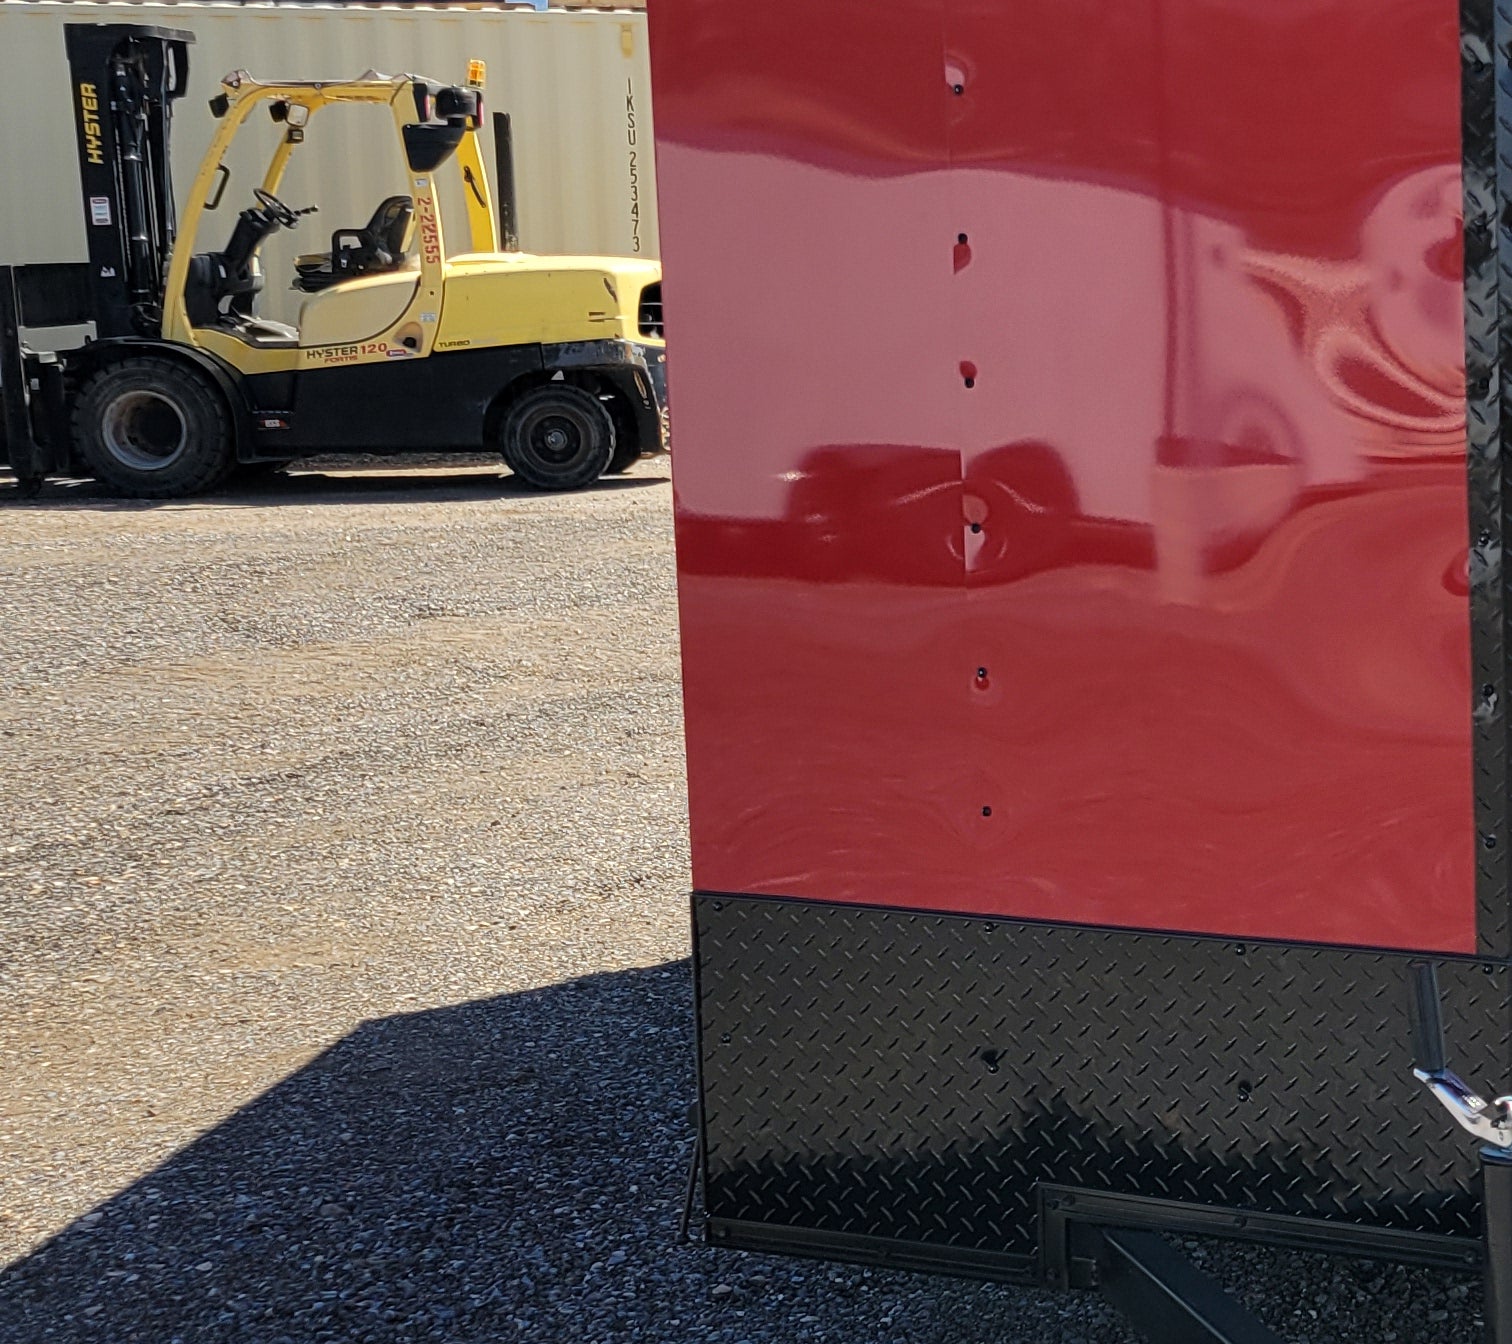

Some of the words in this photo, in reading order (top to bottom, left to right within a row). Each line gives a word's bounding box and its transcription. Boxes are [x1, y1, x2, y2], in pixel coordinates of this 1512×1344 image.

[80, 82, 104, 164] HYSTER
[629, 151, 641, 253] 253473
[306, 345, 358, 360] HYSTER
[360, 343, 388, 355] 120
[438, 339, 471, 348] TURBO
